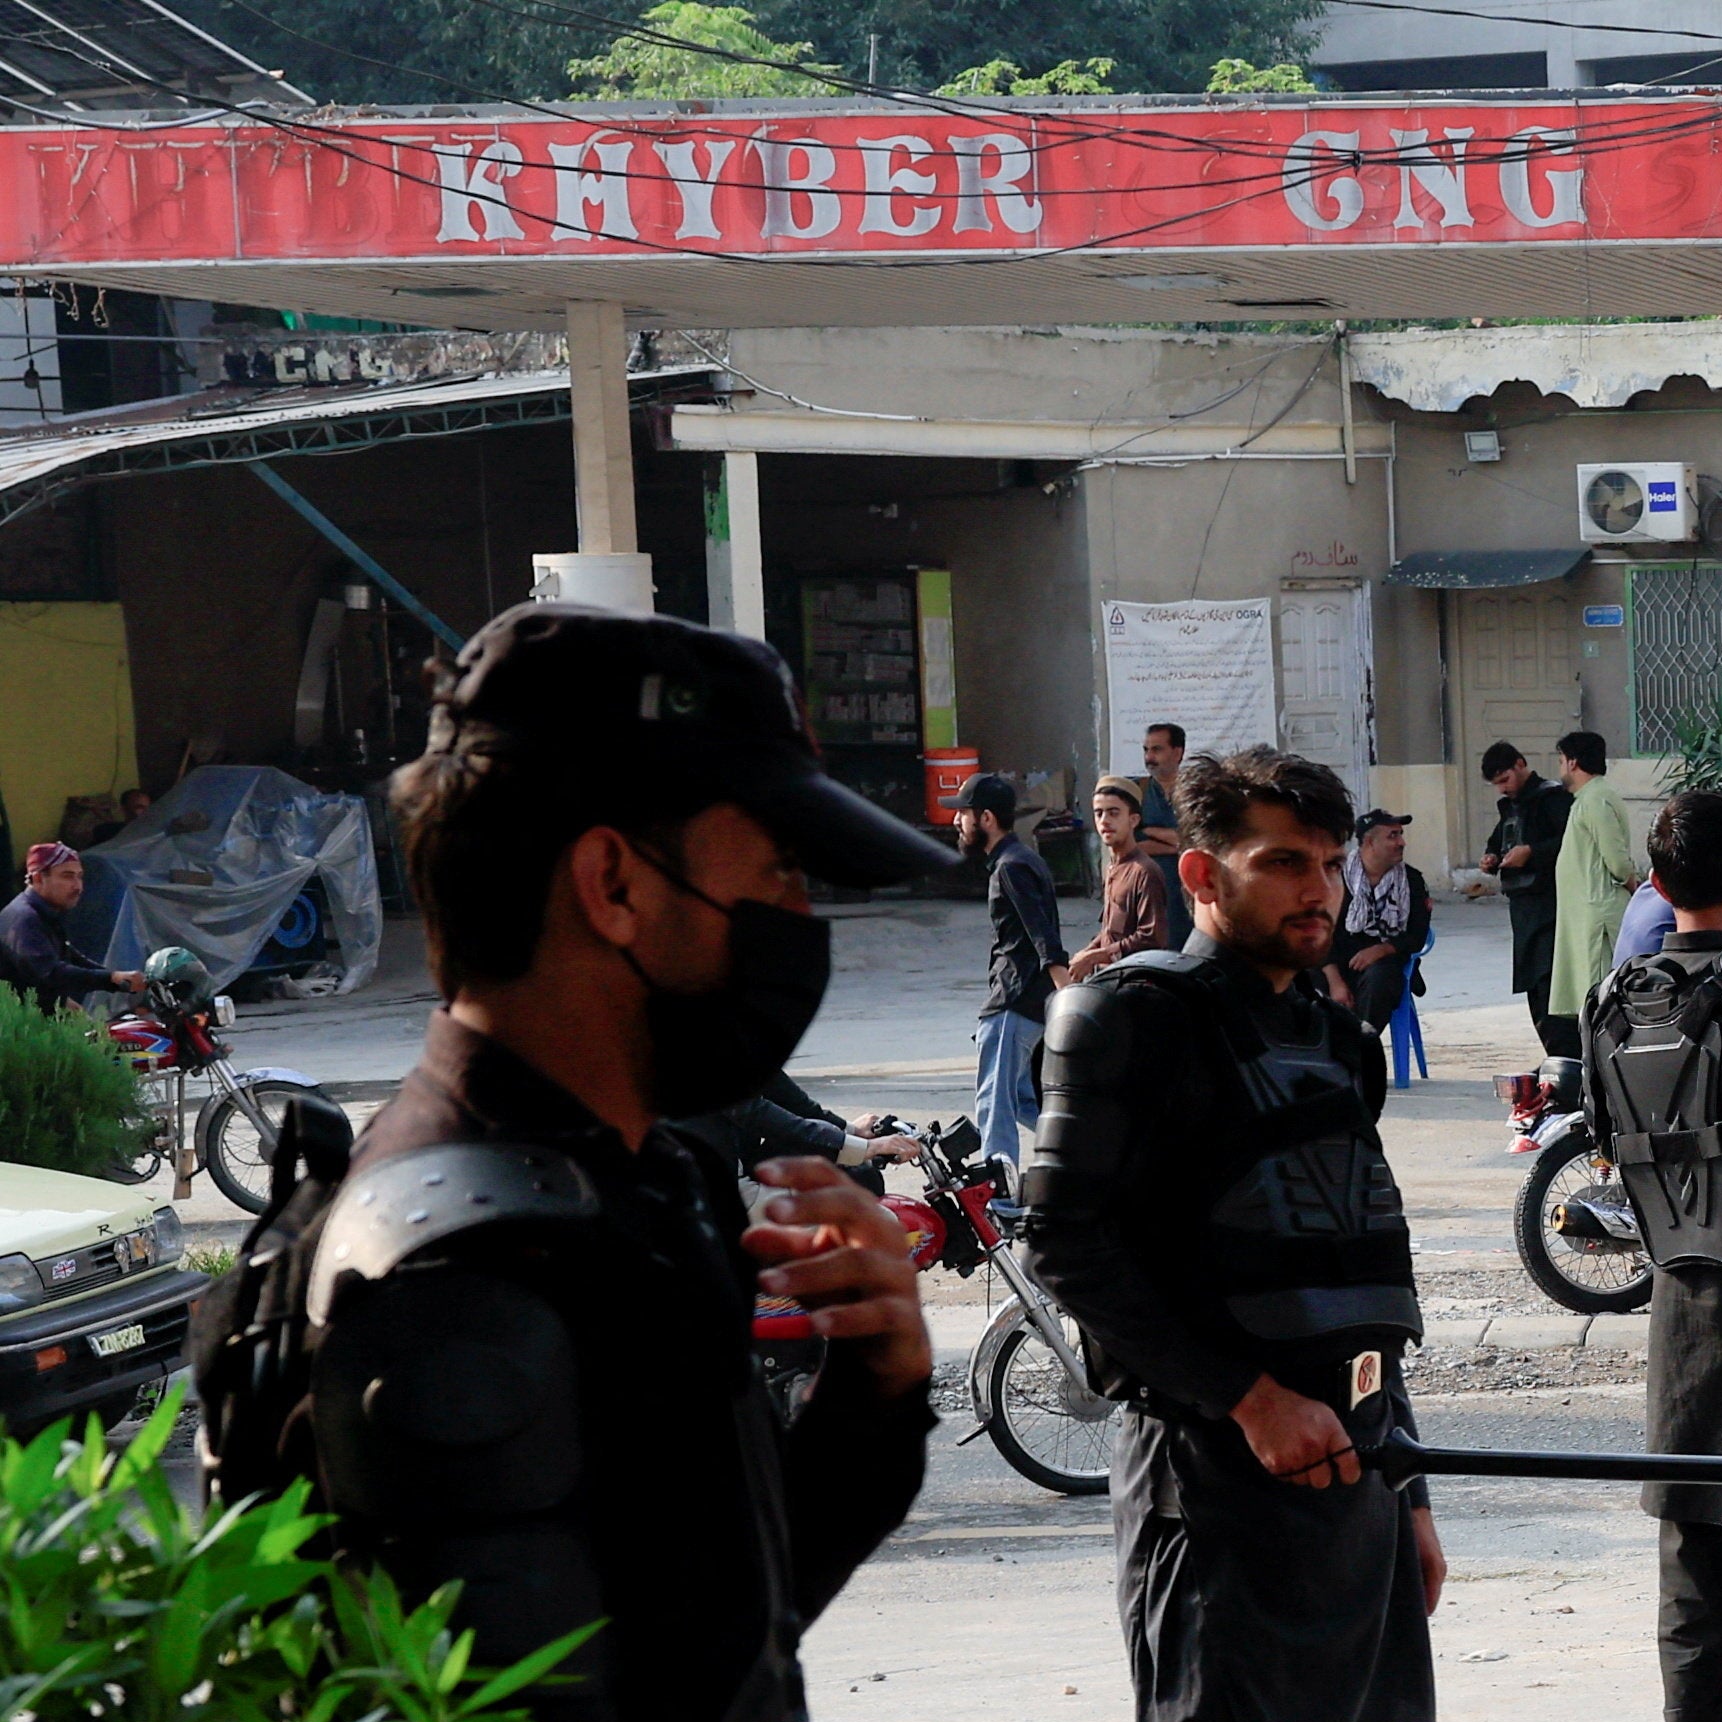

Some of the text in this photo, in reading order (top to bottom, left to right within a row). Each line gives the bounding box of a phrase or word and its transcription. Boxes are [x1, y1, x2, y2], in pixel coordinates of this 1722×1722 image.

[434, 132, 1044, 245] KHYBER
[1281, 125, 1587, 232] CNG
[1649, 492, 1676, 503] Haier
[1236, 609, 1263, 620] OGRA
